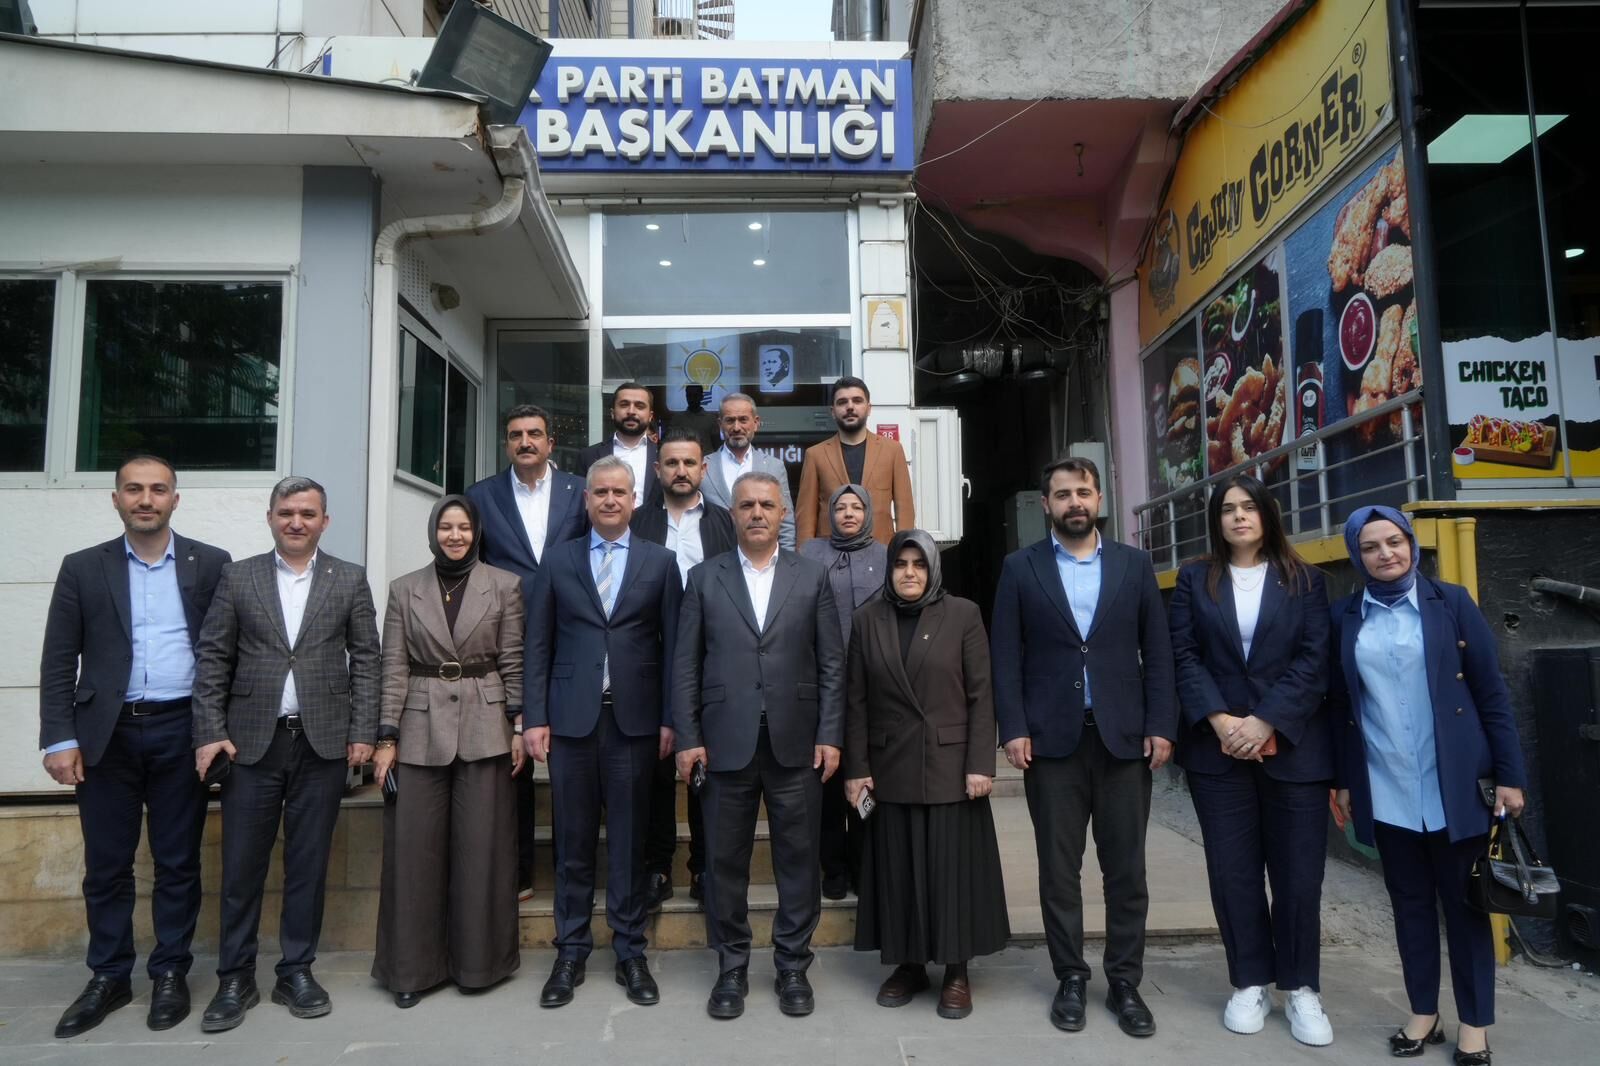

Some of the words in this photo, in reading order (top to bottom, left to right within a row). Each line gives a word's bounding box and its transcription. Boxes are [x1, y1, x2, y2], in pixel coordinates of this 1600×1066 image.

[700, 67, 895, 105] BATMAN
[536, 104, 895, 163] BAŞKANLIĞI
[1250, 71, 1362, 222] CORNER
[1458, 360, 1546, 384] CHICKEN
[1500, 385, 1548, 411] TACO
